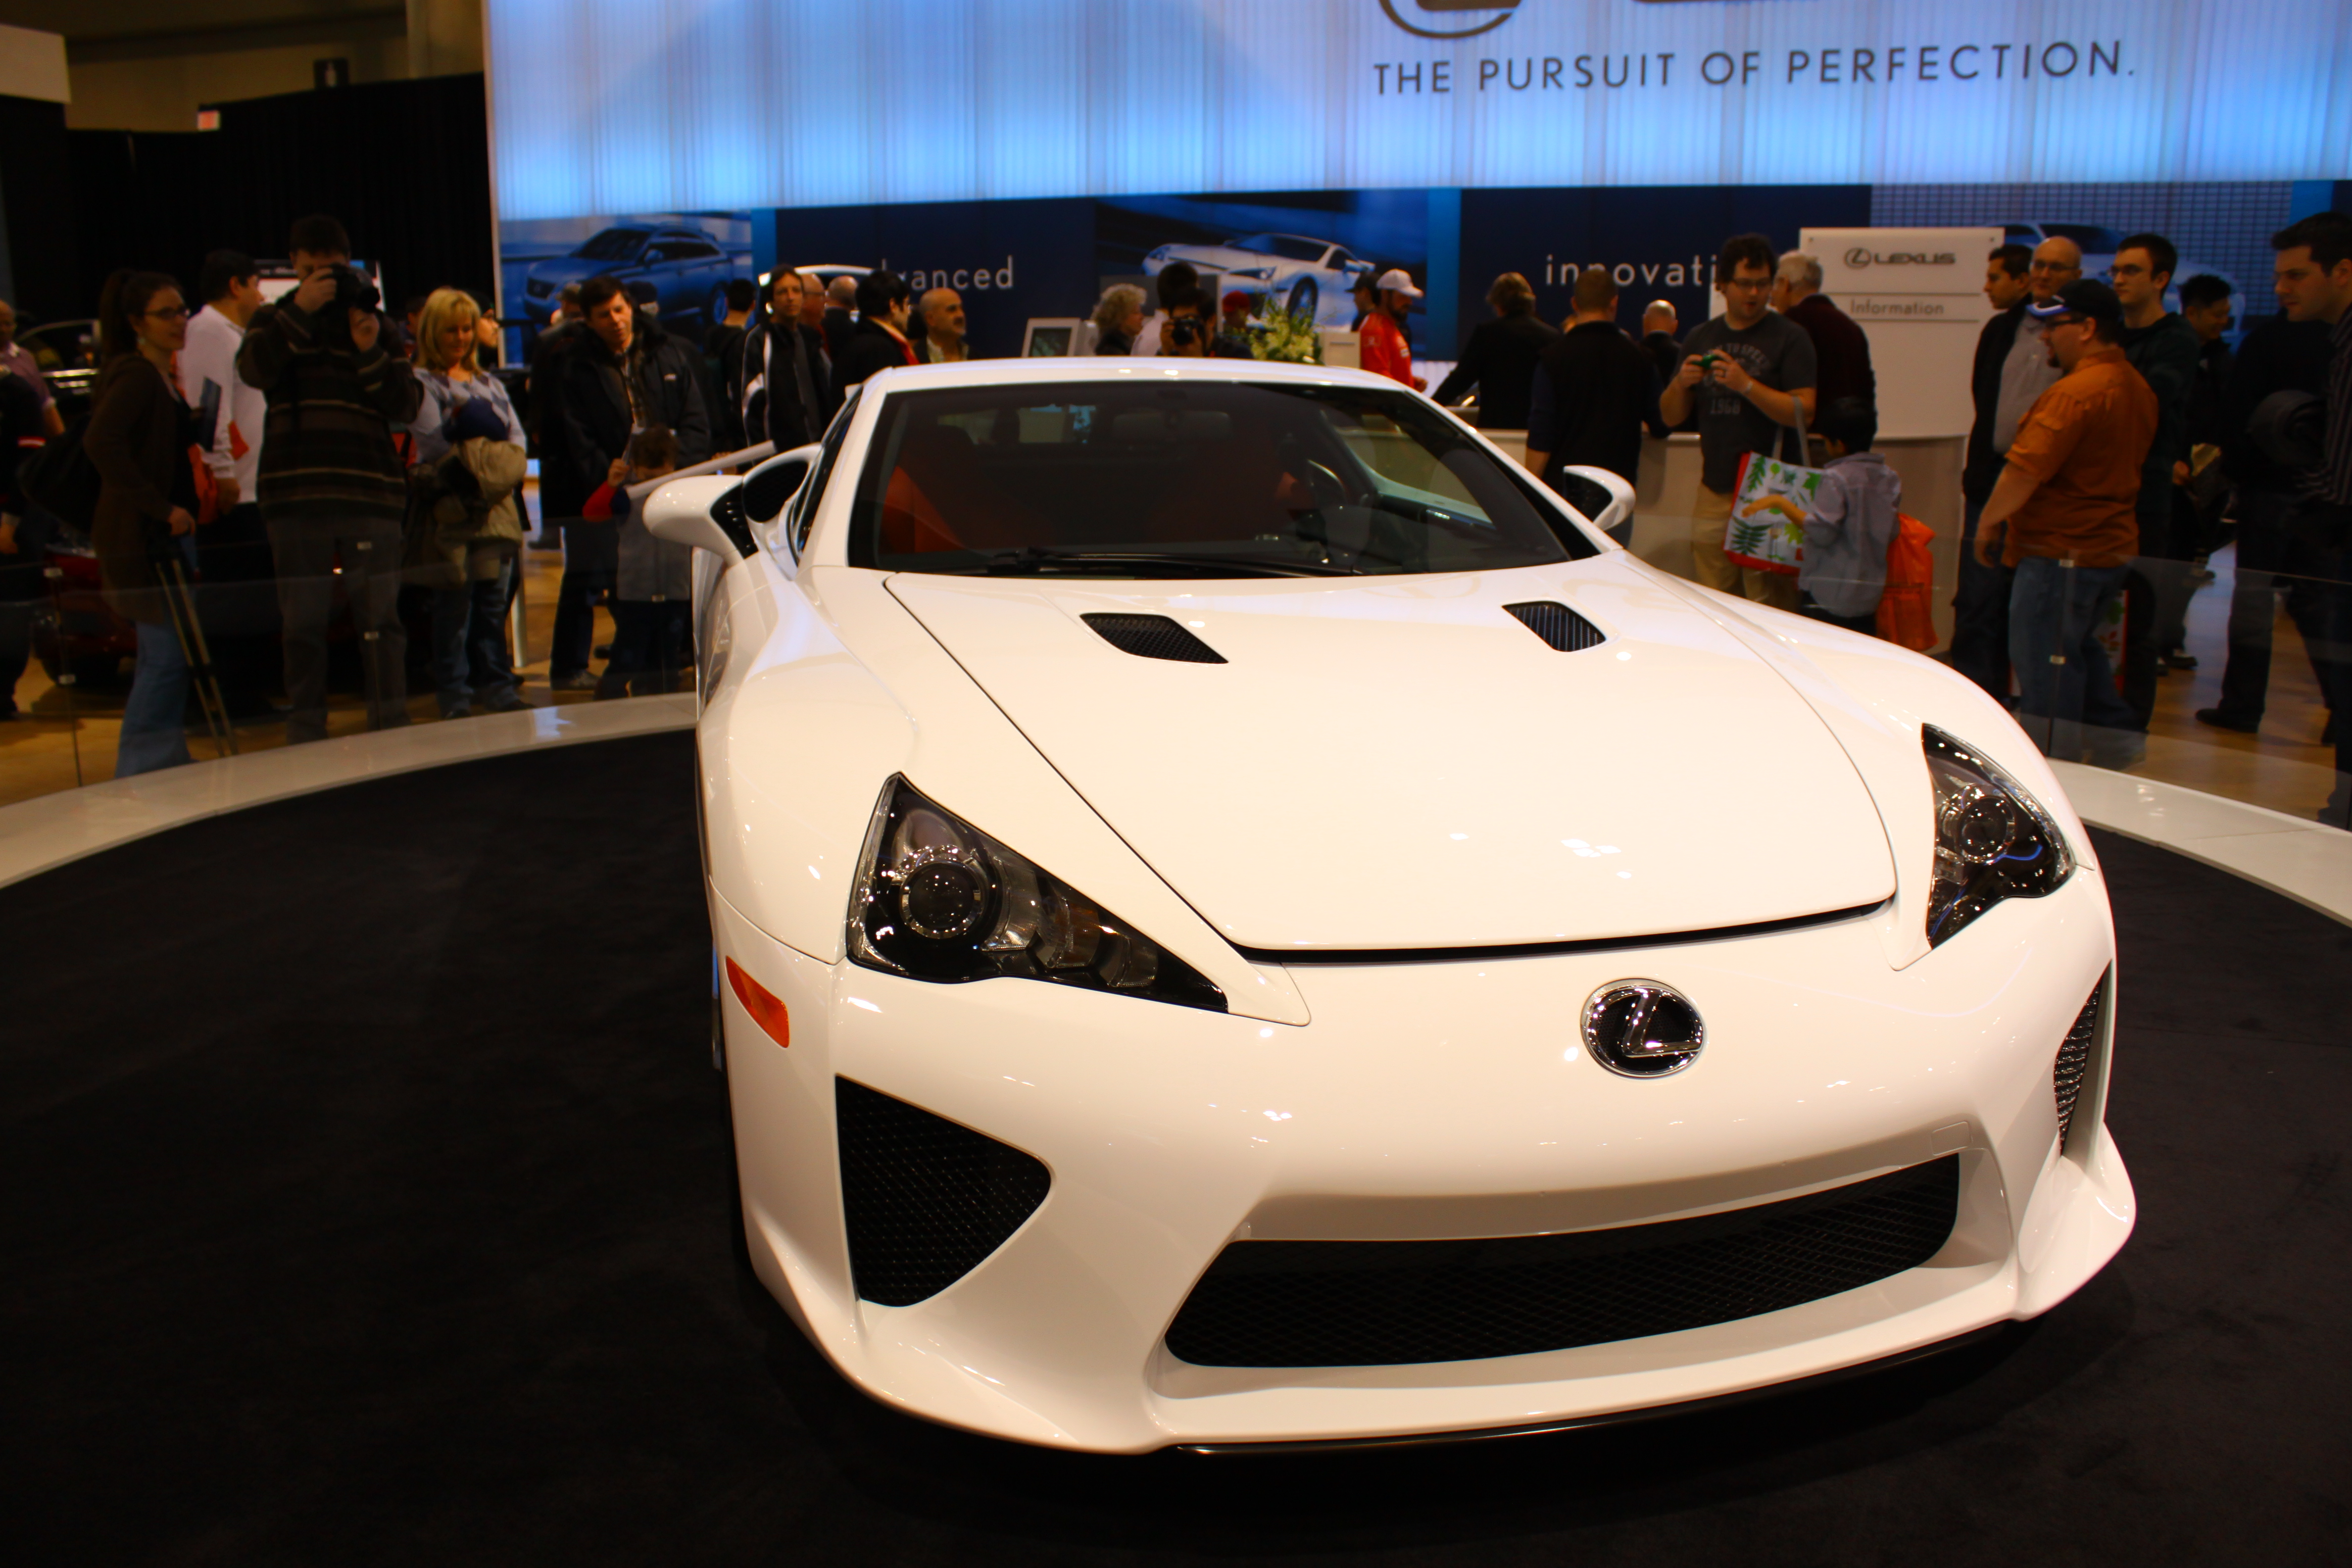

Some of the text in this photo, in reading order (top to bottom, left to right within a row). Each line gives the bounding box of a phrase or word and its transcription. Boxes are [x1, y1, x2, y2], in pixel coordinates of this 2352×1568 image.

[1373, 41, 2135, 95] THE PURSUIT OF PERFECTION.
[1874, 252, 1956, 265] LEXUS
[1850, 298, 1944, 315] Information
